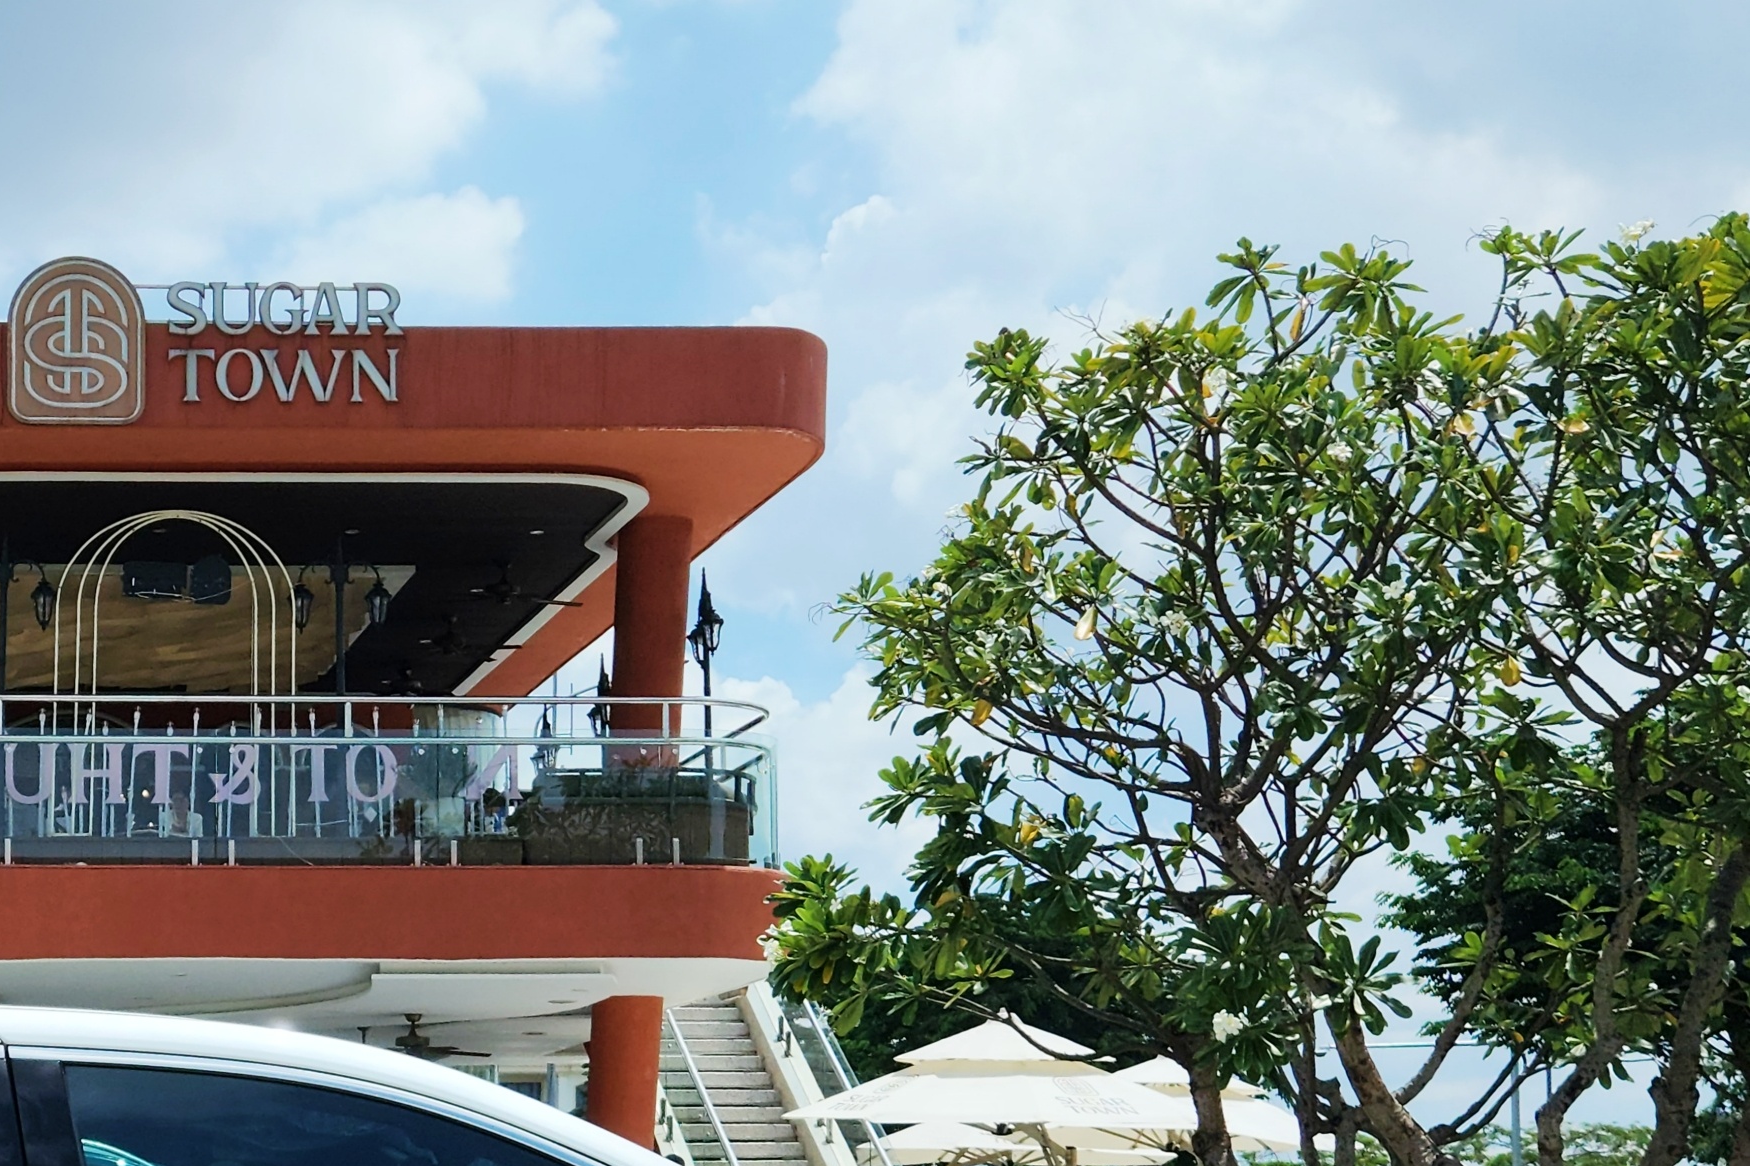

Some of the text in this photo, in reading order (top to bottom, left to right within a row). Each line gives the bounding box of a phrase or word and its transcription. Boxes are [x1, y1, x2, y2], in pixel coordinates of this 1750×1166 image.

[166, 280, 406, 336] SUGAR
[167, 348, 399, 403] TOWN
[1054, 1096, 1130, 1106] SUGAR
[1064, 1105, 1140, 1115] TOWN
